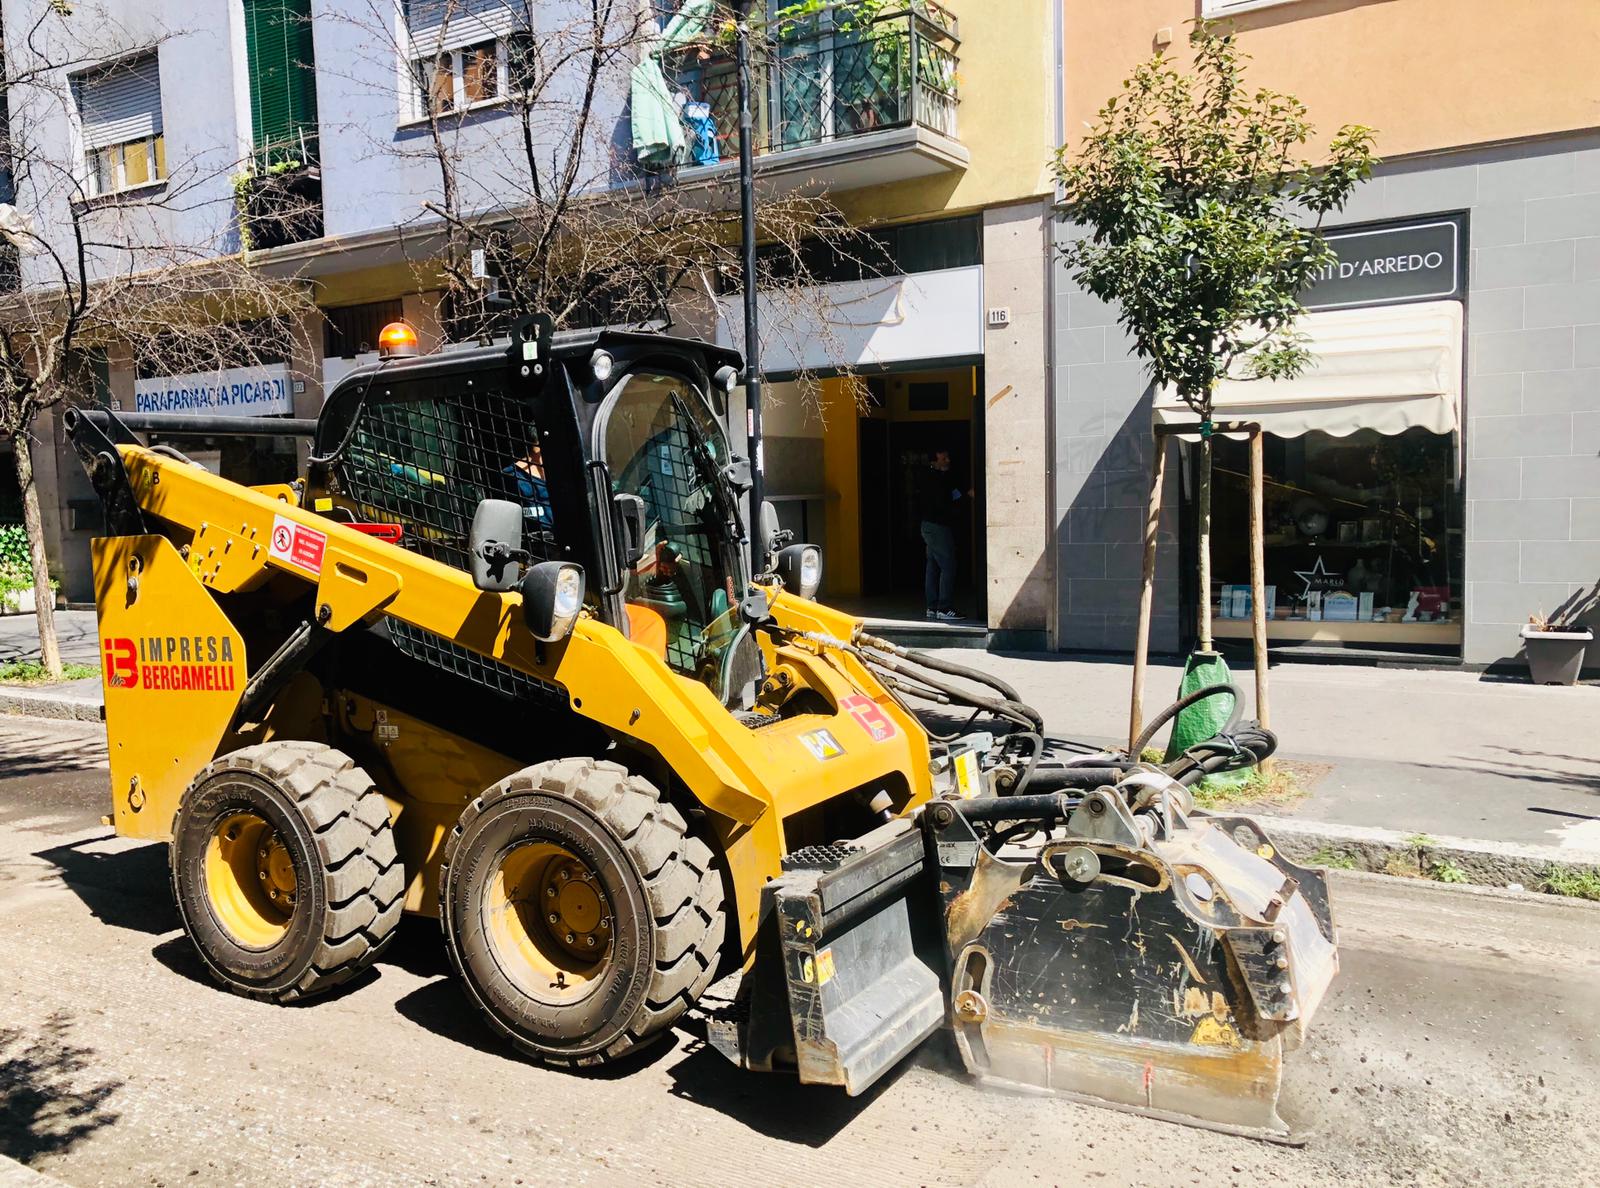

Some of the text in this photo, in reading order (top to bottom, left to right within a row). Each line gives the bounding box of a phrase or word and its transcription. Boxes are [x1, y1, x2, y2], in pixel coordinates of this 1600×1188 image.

[1340, 252, 1443, 279] D'ARREDO
[992, 311, 1006, 321] 116
[136, 379, 285, 412] PARAFARMACIA PICARDI
[140, 636, 233, 662] IMPRESA
[142, 665, 235, 691] BERGAMELLI
